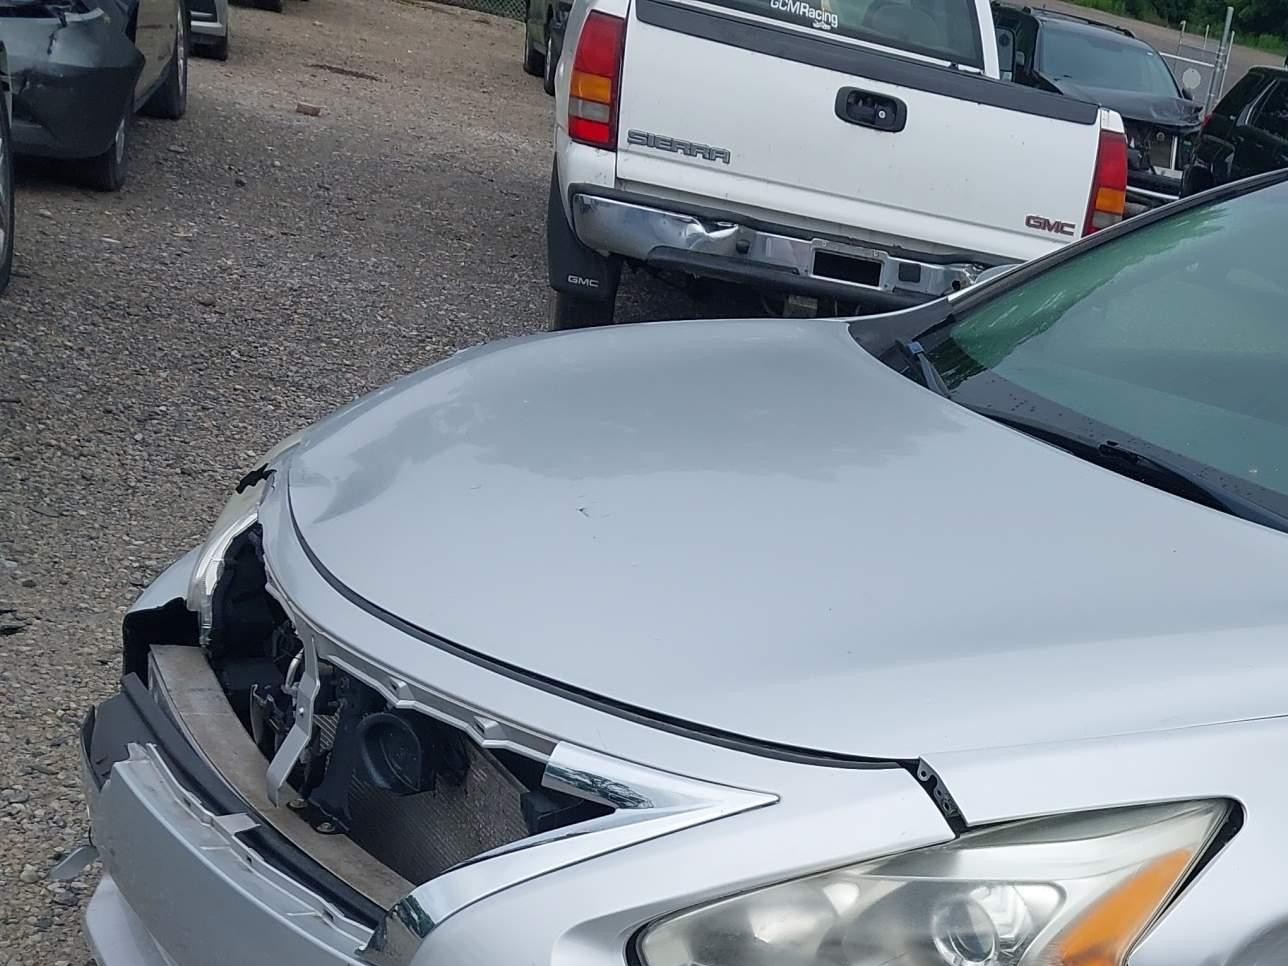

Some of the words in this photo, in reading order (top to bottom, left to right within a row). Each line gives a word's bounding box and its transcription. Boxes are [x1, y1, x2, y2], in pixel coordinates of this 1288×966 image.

[627, 128, 731, 165] SIERRA
[1025, 215, 1076, 237] GMC
[567, 274, 600, 288] GMC
